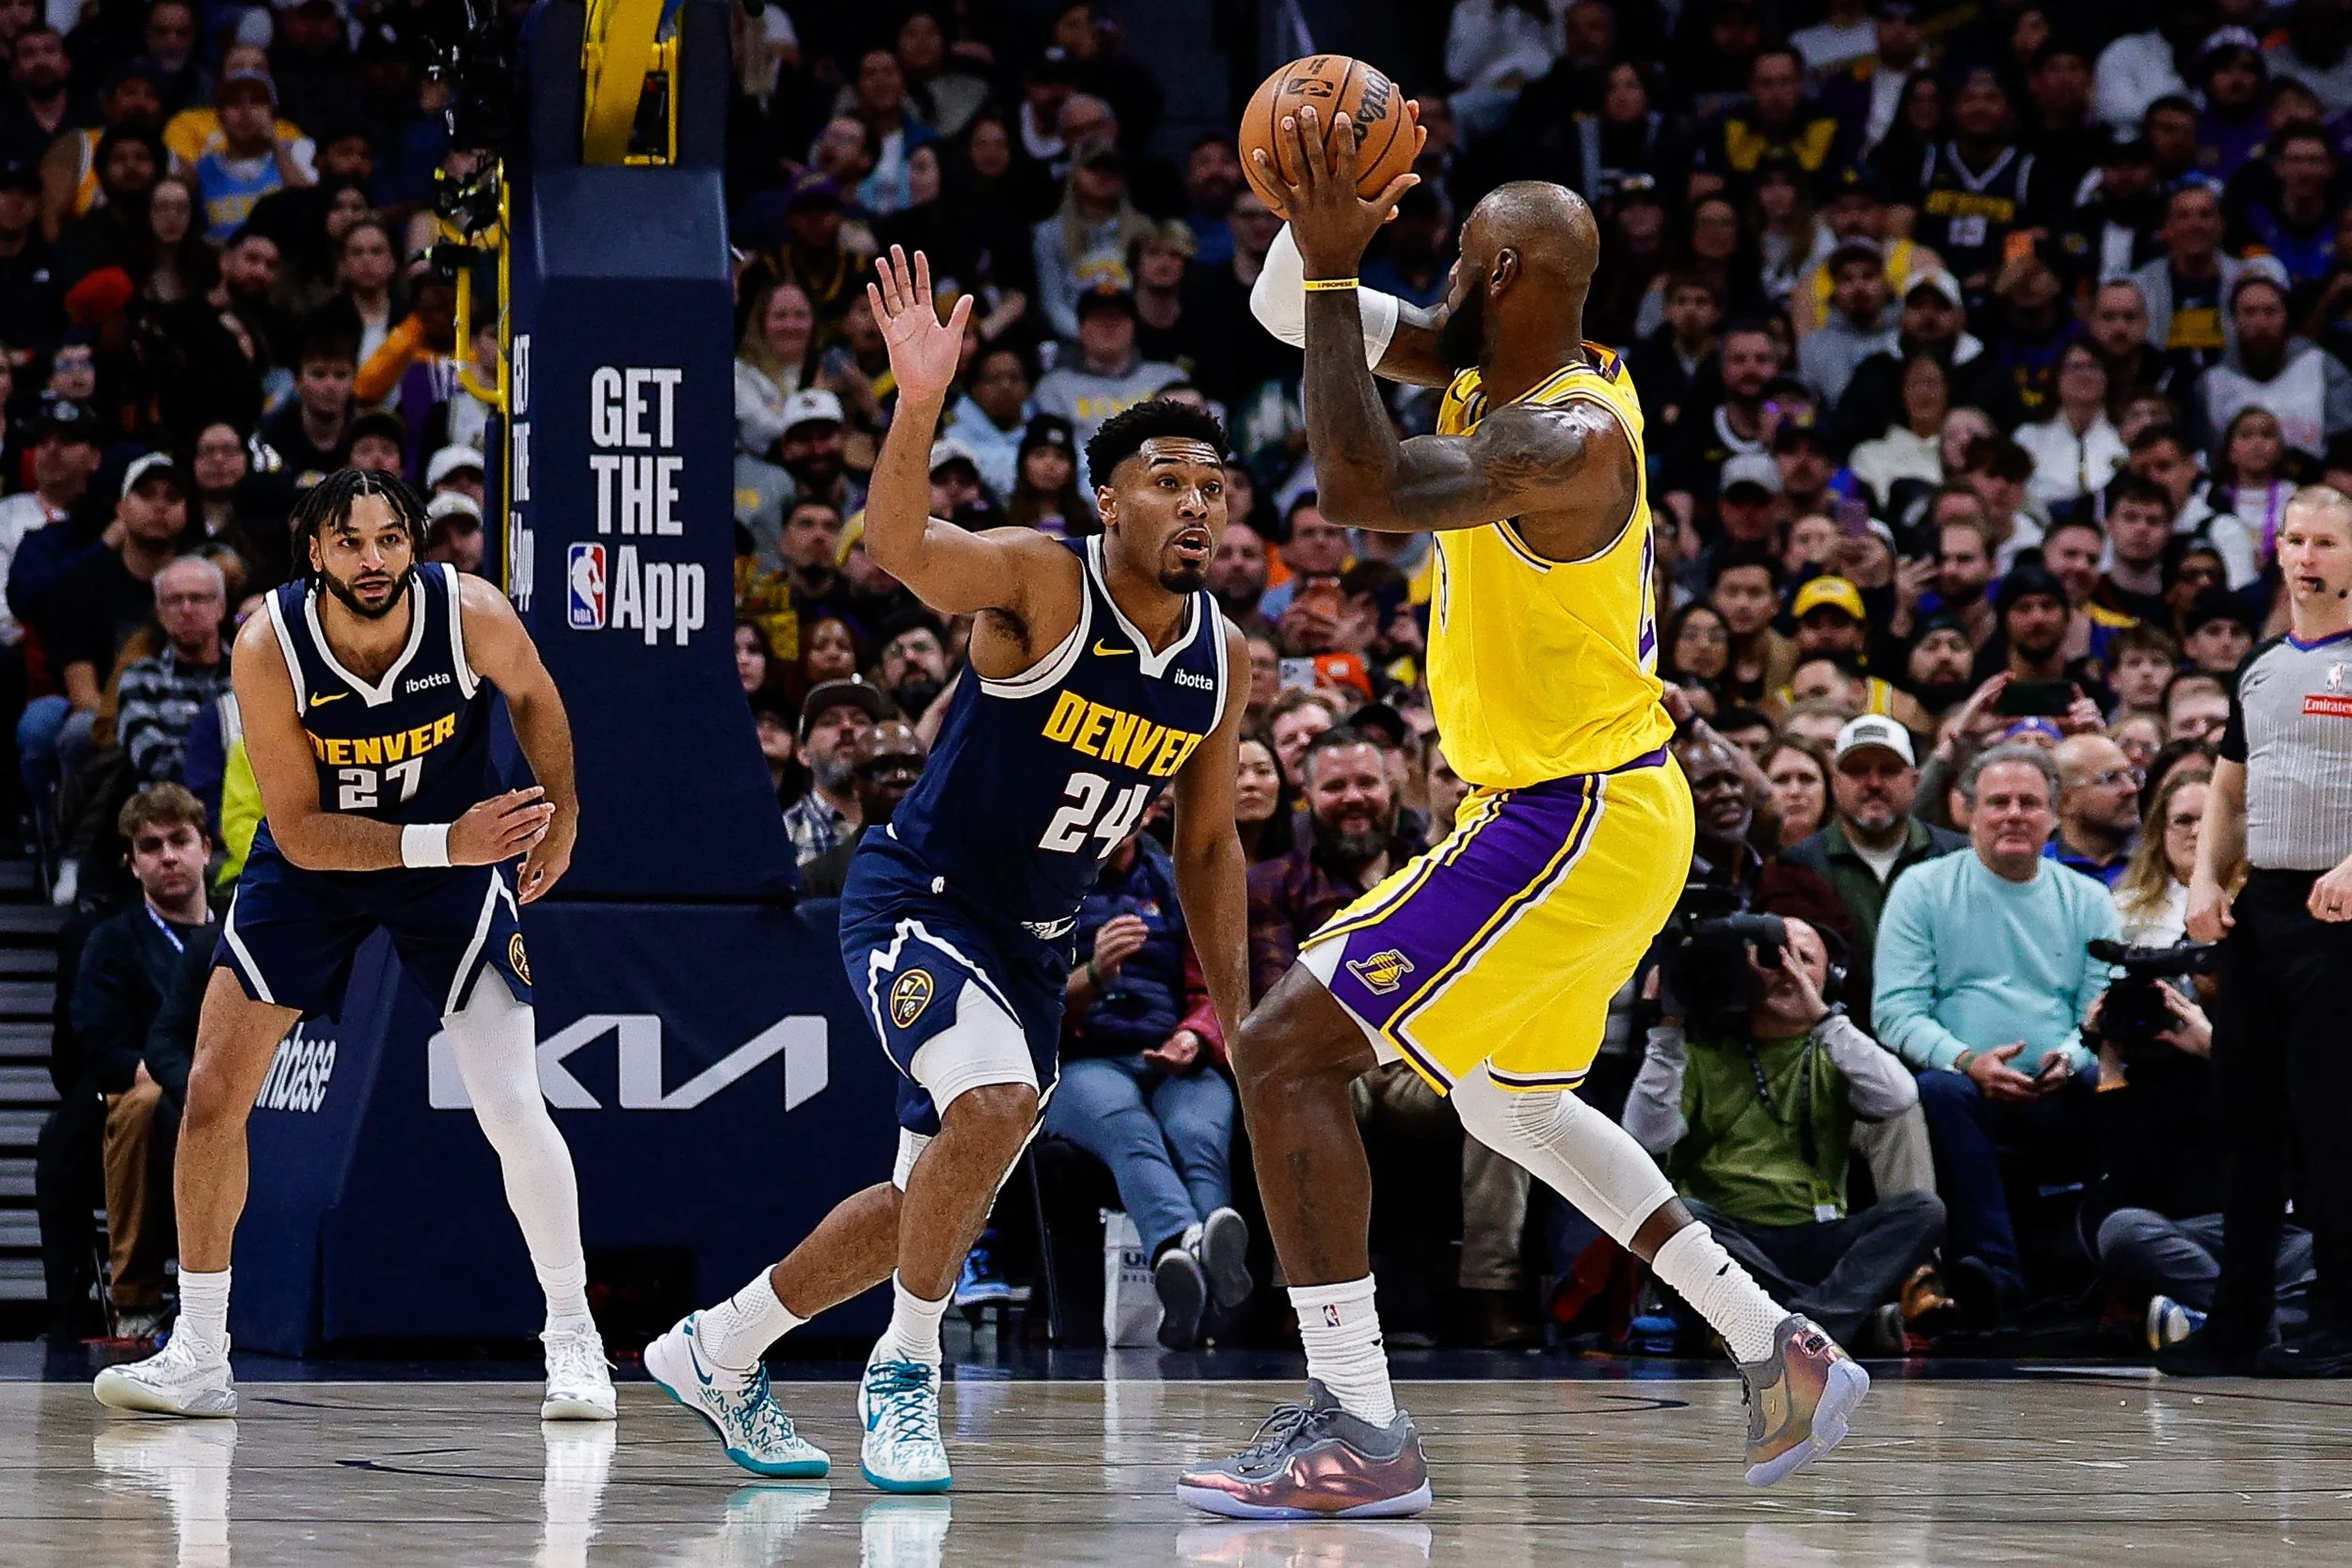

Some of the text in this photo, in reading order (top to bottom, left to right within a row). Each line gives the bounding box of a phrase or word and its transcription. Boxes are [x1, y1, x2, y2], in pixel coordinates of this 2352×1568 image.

[1353, 71, 1391, 150] Wilso
[591, 366, 683, 449] GET
[589, 454, 684, 536] THE
[612, 544, 706, 646] App
[405, 673, 451, 694] ibotta
[1174, 668, 1214, 691] ibotta
[305, 712, 456, 766] DENVER
[1041, 689, 1203, 777] DENVER
[339, 756, 423, 810] 27
[1038, 771, 1152, 860] 24
